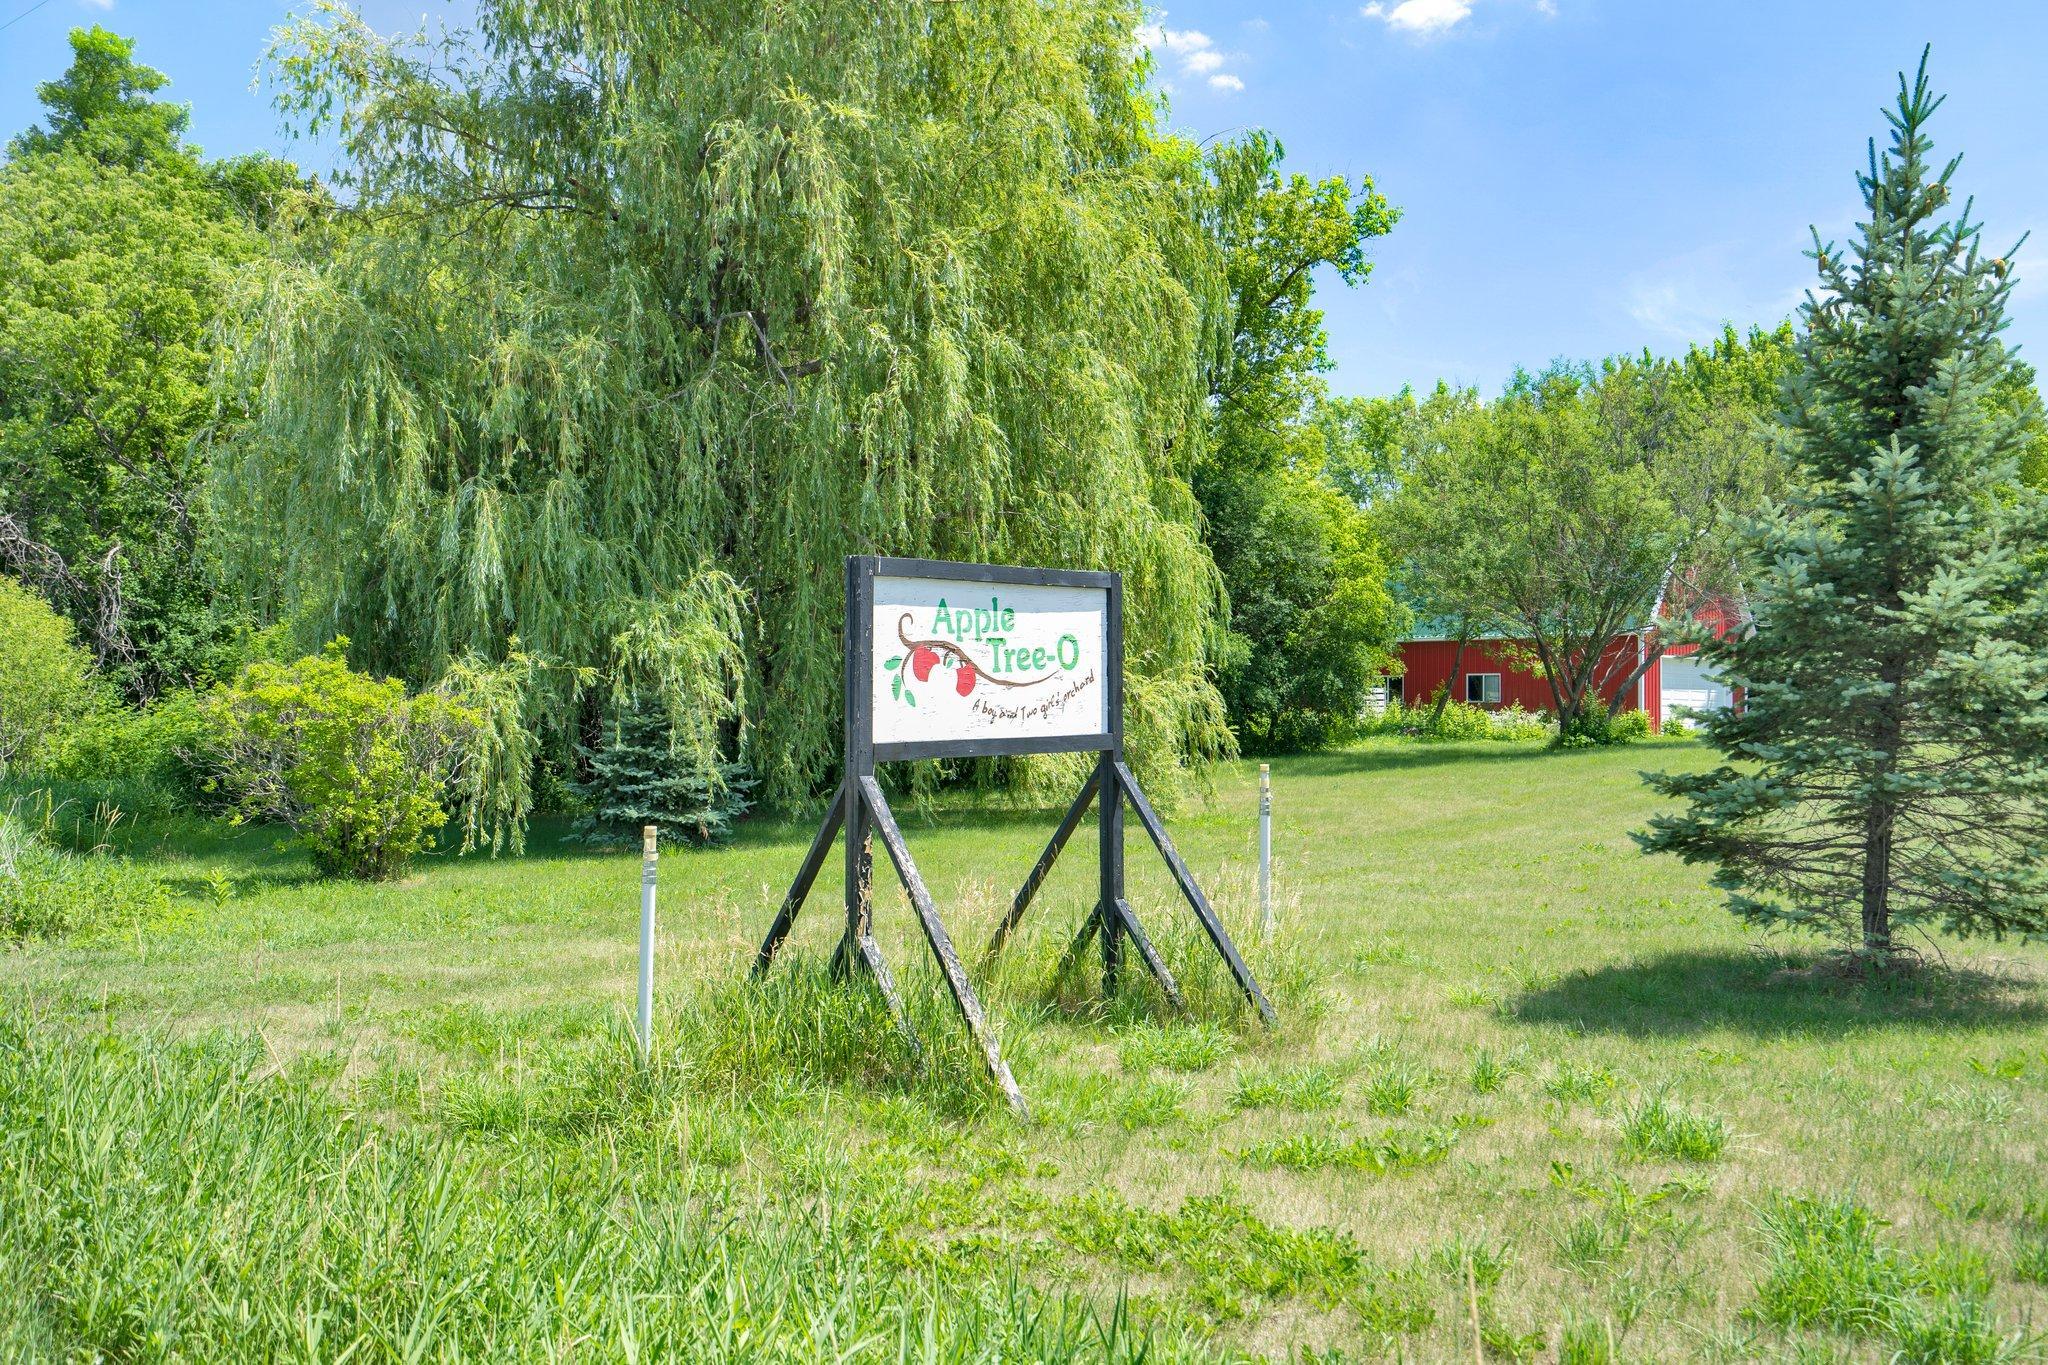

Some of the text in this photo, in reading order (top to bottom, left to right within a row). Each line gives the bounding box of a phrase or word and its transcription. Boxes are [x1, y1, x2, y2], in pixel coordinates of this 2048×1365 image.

[931, 597, 1015, 642] Apple
[986, 634, 1079, 673] Tree-O
[972, 698, 981, 711] A
[982, 700, 997, 725] boy
[1063, 668, 1094, 702] orchard
